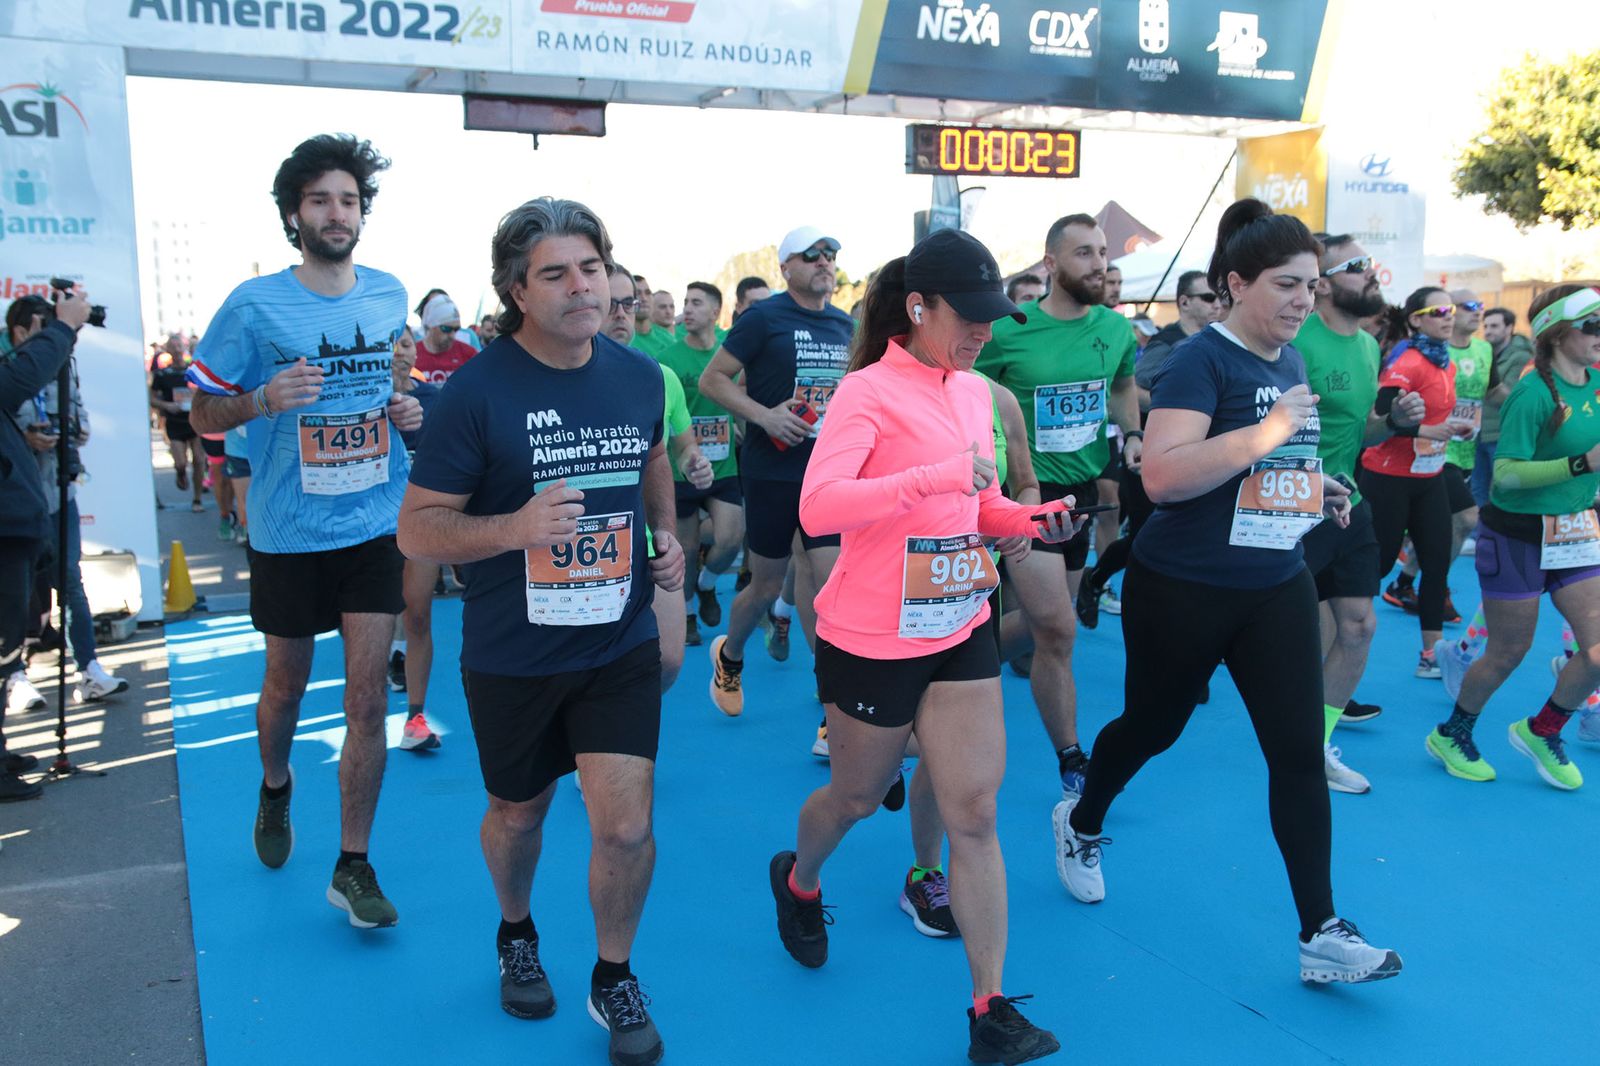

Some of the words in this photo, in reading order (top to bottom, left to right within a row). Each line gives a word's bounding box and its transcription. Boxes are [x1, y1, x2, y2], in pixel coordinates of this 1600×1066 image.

[916, 3, 1000, 47] NEXA
[1028, 8, 1099, 49] CDX
[537, 30, 629, 54] RAMÓN
[640, 38, 694, 60] RUIZ
[704, 43, 813, 68] ANDÚJAR
[1126, 56, 1180, 74] ALMERÍA
[1344, 180, 1410, 194] HYUNDAI
[1045, 393, 1100, 417] 1632
[312, 422, 379, 451] 1491
[529, 429, 575, 447] Medio
[580, 424, 640, 439] Maratón
[693, 424, 725, 437] 1641
[532, 441, 598, 465] Almería
[532, 465, 571, 480] RAMÓN
[574, 462, 596, 473] RUIZ
[599, 458, 642, 471] ANDÚJAR
[1260, 471, 1312, 500] 963
[550, 532, 618, 569] 964
[569, 568, 604, 578] DANIEL
[930, 550, 986, 585] 962
[943, 582, 974, 593] KARINA
